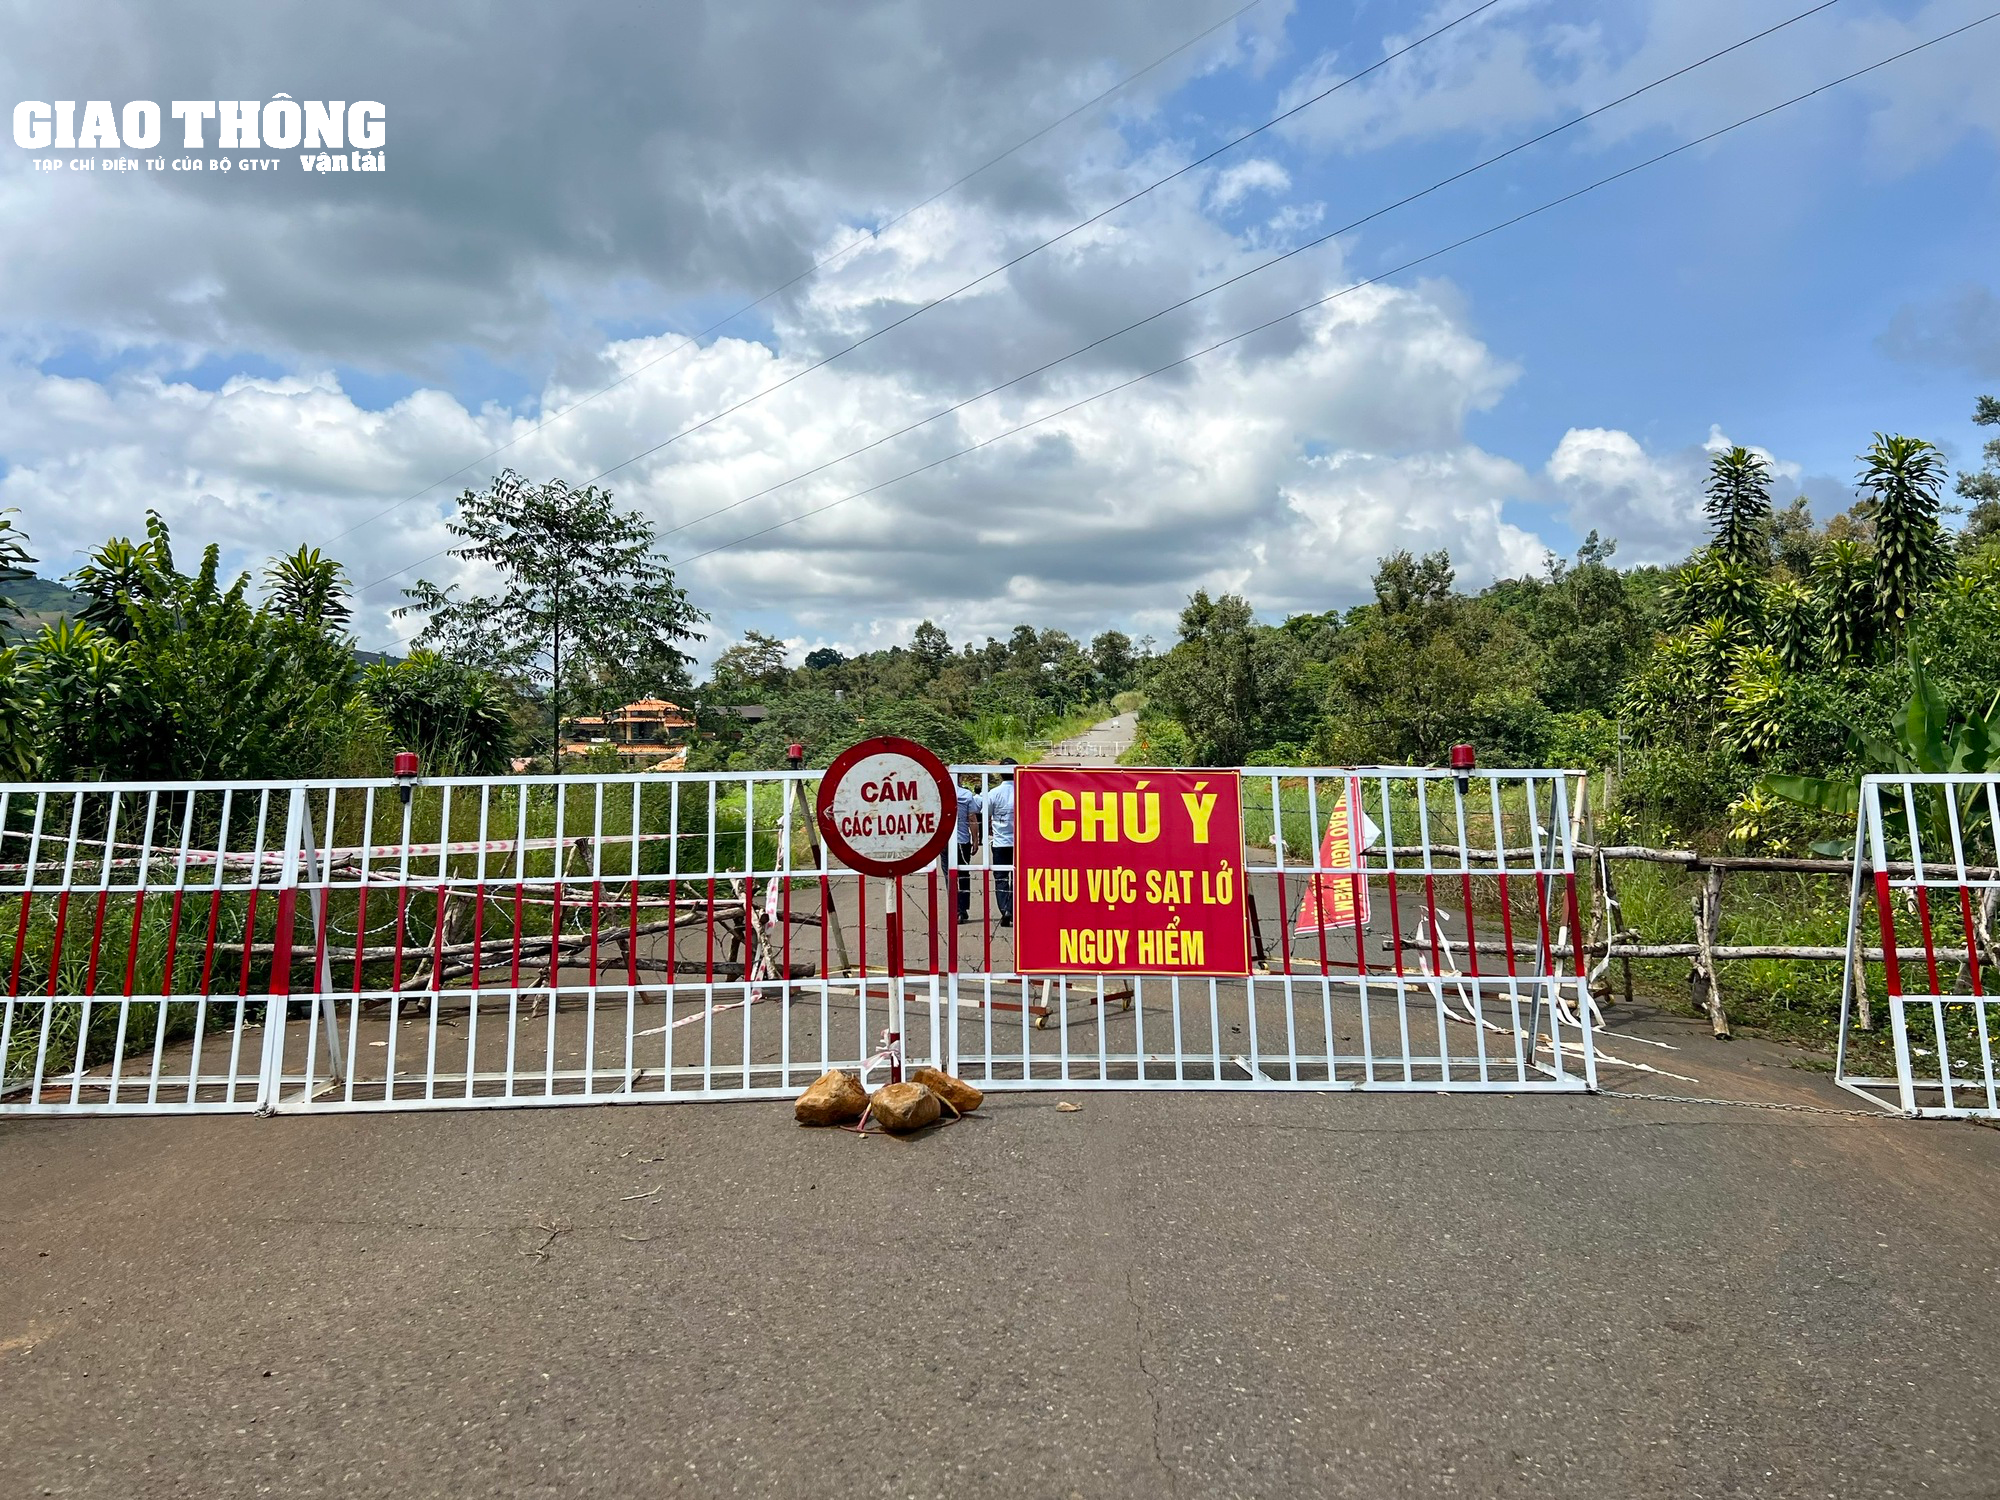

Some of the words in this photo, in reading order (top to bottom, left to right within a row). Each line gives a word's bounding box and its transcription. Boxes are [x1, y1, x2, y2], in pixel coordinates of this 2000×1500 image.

[860, 771, 918, 803] CẤM
[841, 809, 873, 838] CÁC
[877, 814, 912, 841] LOẠI
[916, 813, 935, 834] XE
[1038, 780, 1161, 844] CHÚ
[1181, 781, 1218, 844] Ý
[1330, 839, 1351, 869] NGU
[1027, 868, 1079, 903] KHU
[1086, 865, 1137, 911] VỰC
[1145, 869, 1194, 912] SẠT
[1201, 859, 1234, 906] LỞ
[1059, 928, 1129, 965] NGUY
[1138, 915, 1205, 966] HIỂM
